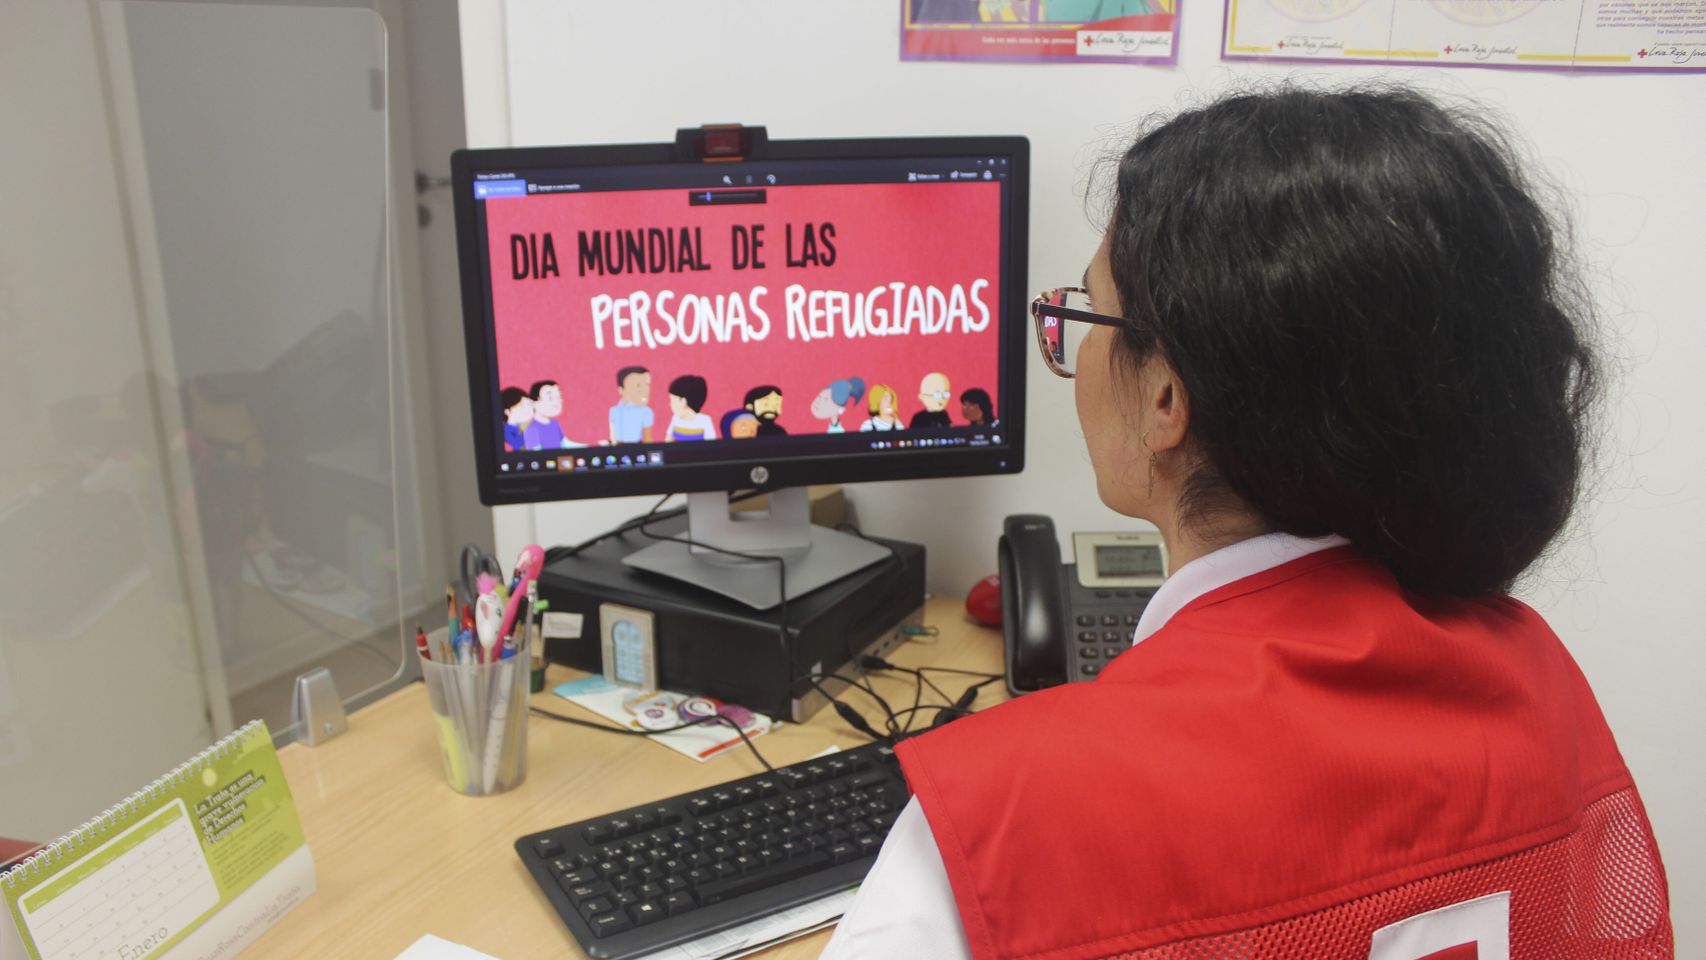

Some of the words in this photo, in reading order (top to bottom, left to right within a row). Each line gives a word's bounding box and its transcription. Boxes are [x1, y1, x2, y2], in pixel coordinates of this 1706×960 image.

[510, 232, 560, 280] DIA
[578, 226, 711, 277] MUNDIAL
[732, 224, 765, 270] DE
[785, 222, 836, 268] LAS
[590, 285, 771, 350] PERSONAS
[785, 278, 990, 342] REFUGIADAS
[194, 803, 208, 814] La
[208, 789, 229, 806] Trata
[117, 926, 169, 960] Enero
